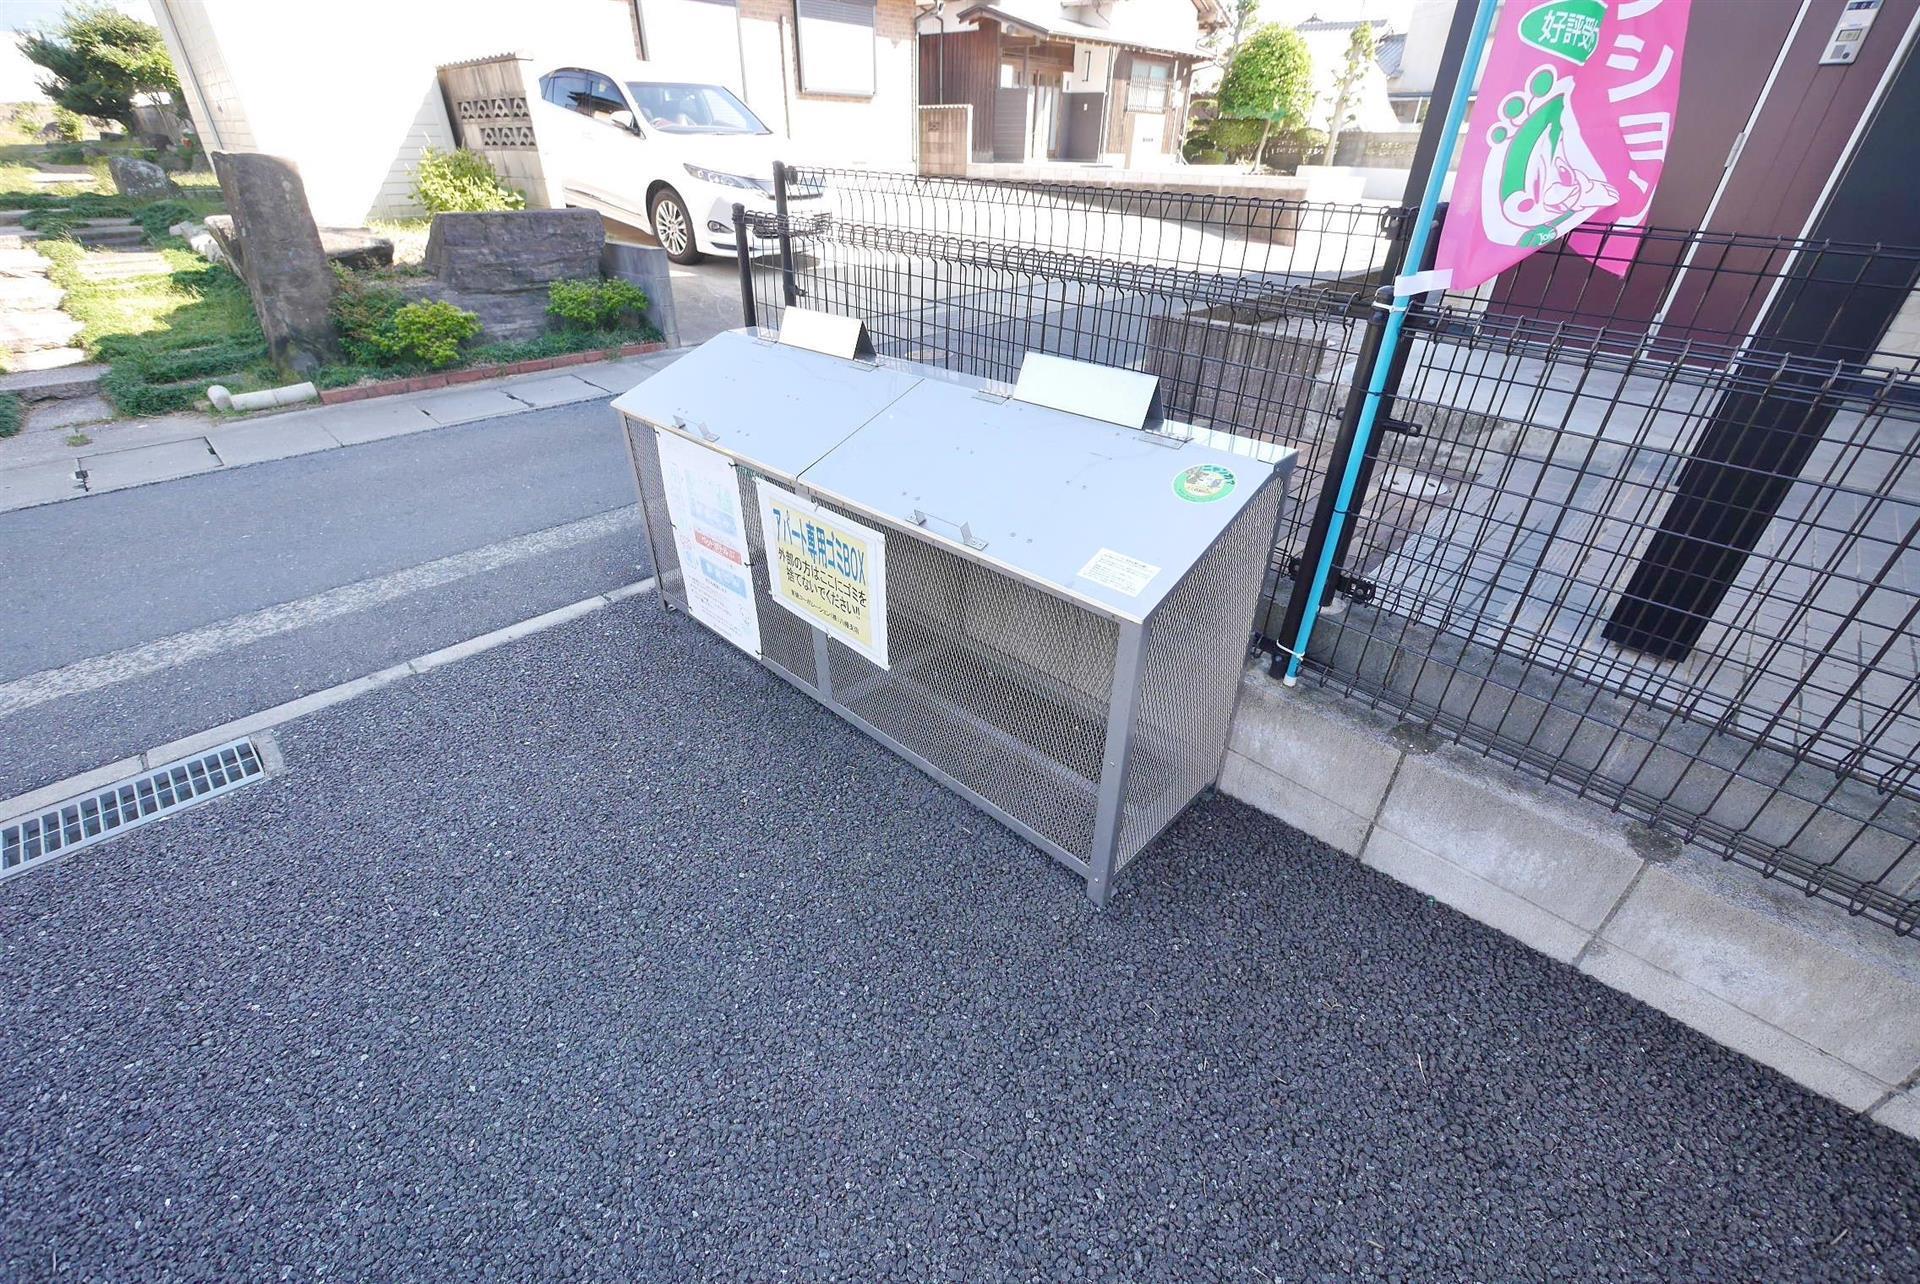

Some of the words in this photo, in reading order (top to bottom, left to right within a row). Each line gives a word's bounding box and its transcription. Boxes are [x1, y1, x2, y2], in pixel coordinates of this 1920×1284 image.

[773, 508, 866, 585] アパート専用ゴミBOX
[778, 547, 867, 607] 外部の方はここにゴミを
